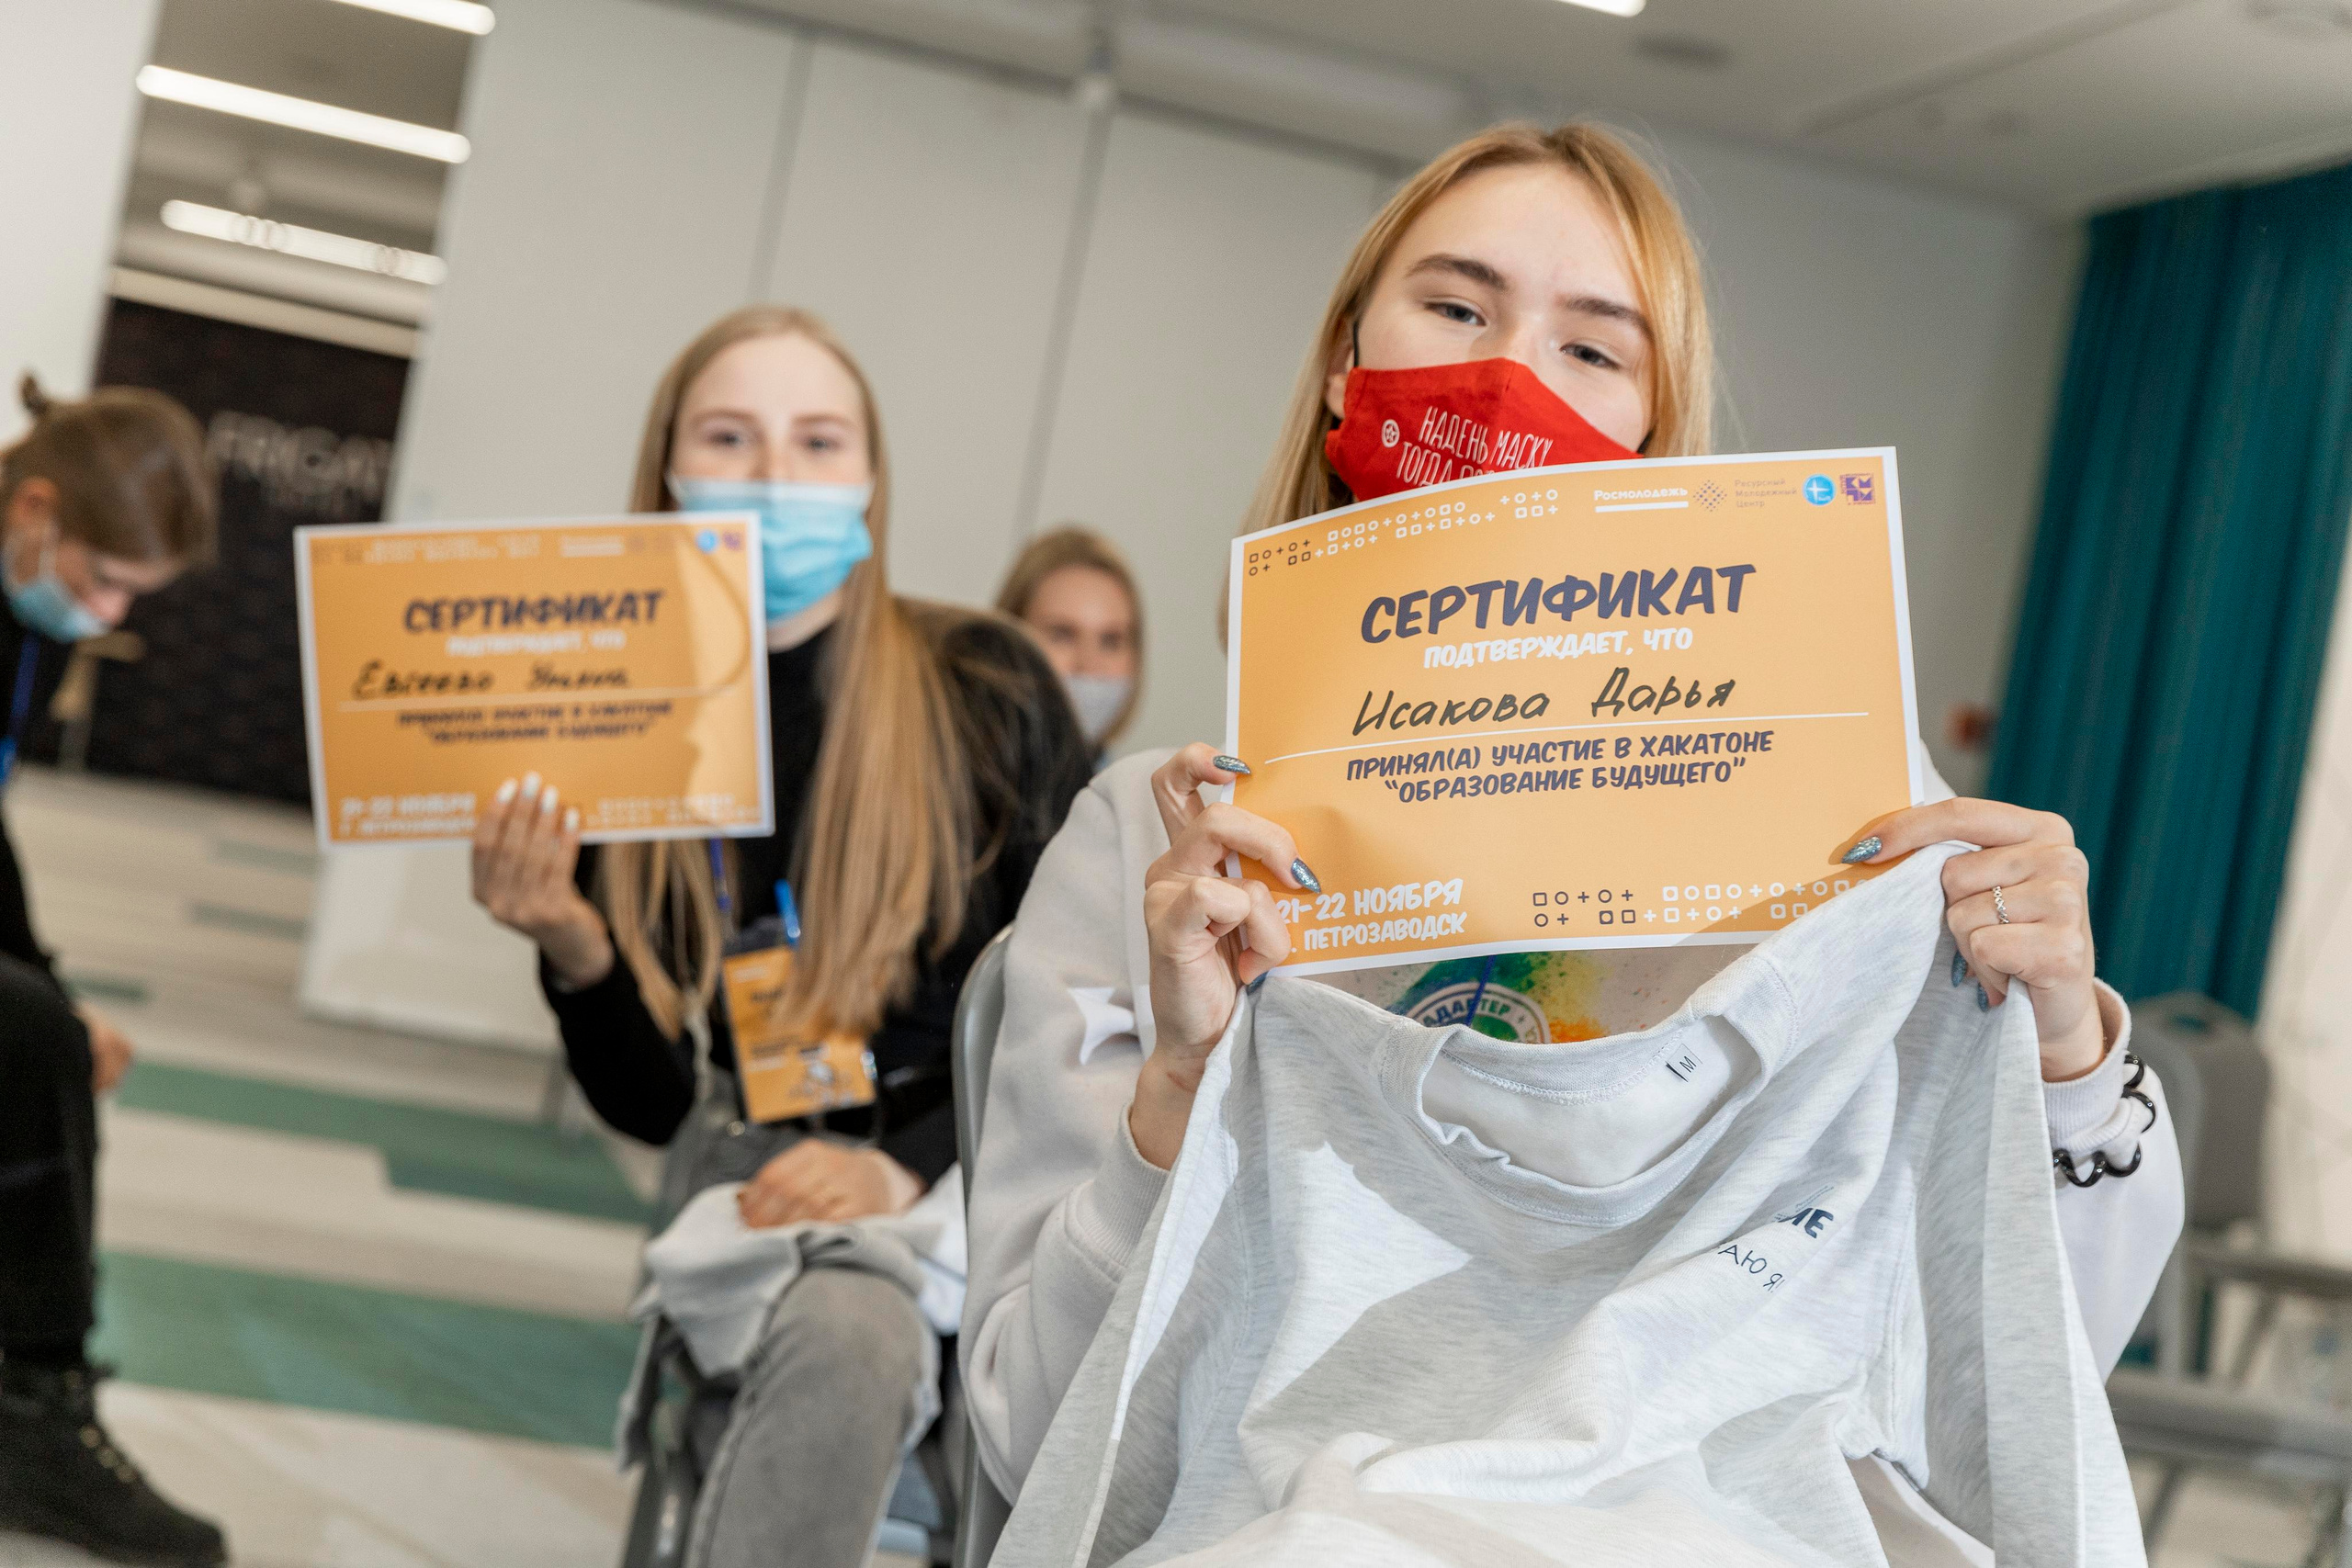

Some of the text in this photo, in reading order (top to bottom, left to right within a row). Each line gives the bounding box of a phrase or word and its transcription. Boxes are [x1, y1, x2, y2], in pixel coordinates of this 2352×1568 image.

[1418, 405, 1554, 469] НАДЕНЬ МАСКУ
[1396, 441, 1453, 487] ТОГДА
[1735, 478, 1786, 489] Ресурсный
[1593, 488, 1689, 502] Росмолодежь
[403, 590, 665, 633] СЕРТИФИКАТ
[1361, 564, 1757, 643] СЕРТИФИКАТ
[1424, 627, 1693, 669] ПОДТВЕРЖДАЕТ, ЧТО
[1352, 666, 1736, 736] Исакова Дарья
[1347, 730, 1774, 781] ПРИНЯЛ(А) УЧАСТИЕ В ХАКАТОНЕ
[1276, 878, 1464, 924] 21-22 НОЯБРЯ
[1304, 911, 1467, 951] ПЕТРОЗАВОДСК
